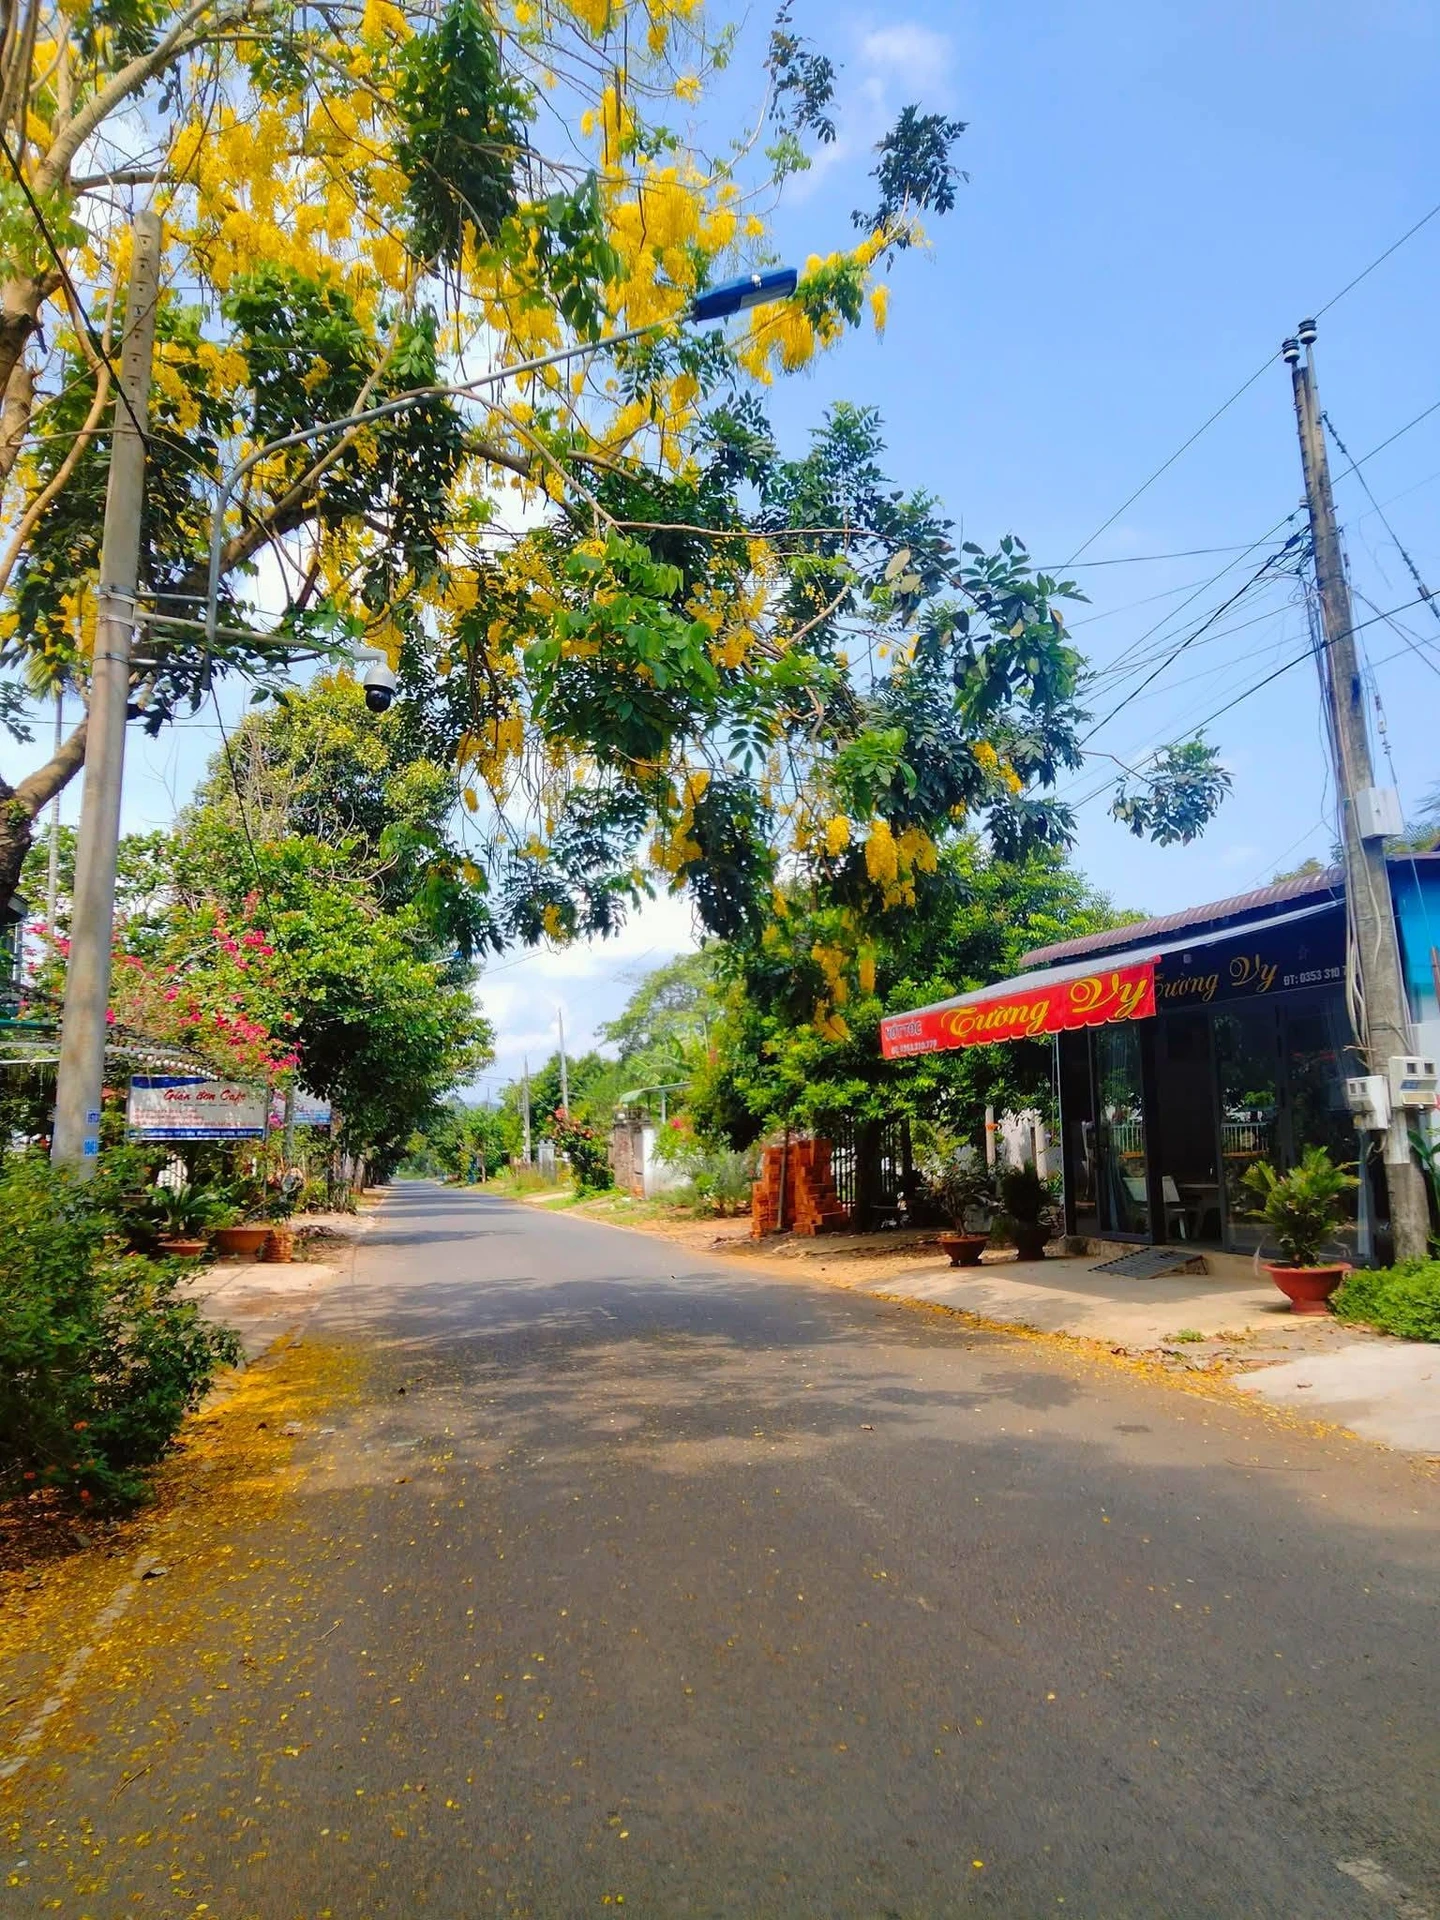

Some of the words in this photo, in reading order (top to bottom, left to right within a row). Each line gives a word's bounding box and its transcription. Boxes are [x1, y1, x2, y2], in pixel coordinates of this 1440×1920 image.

[1229, 954, 1279, 993] Vy
[1300, 969, 1322, 983] 0353
[1323, 967, 1340, 979] 310
[940, 1000, 1050, 1037] Tường
[1070, 973, 1149, 1019] Vy
